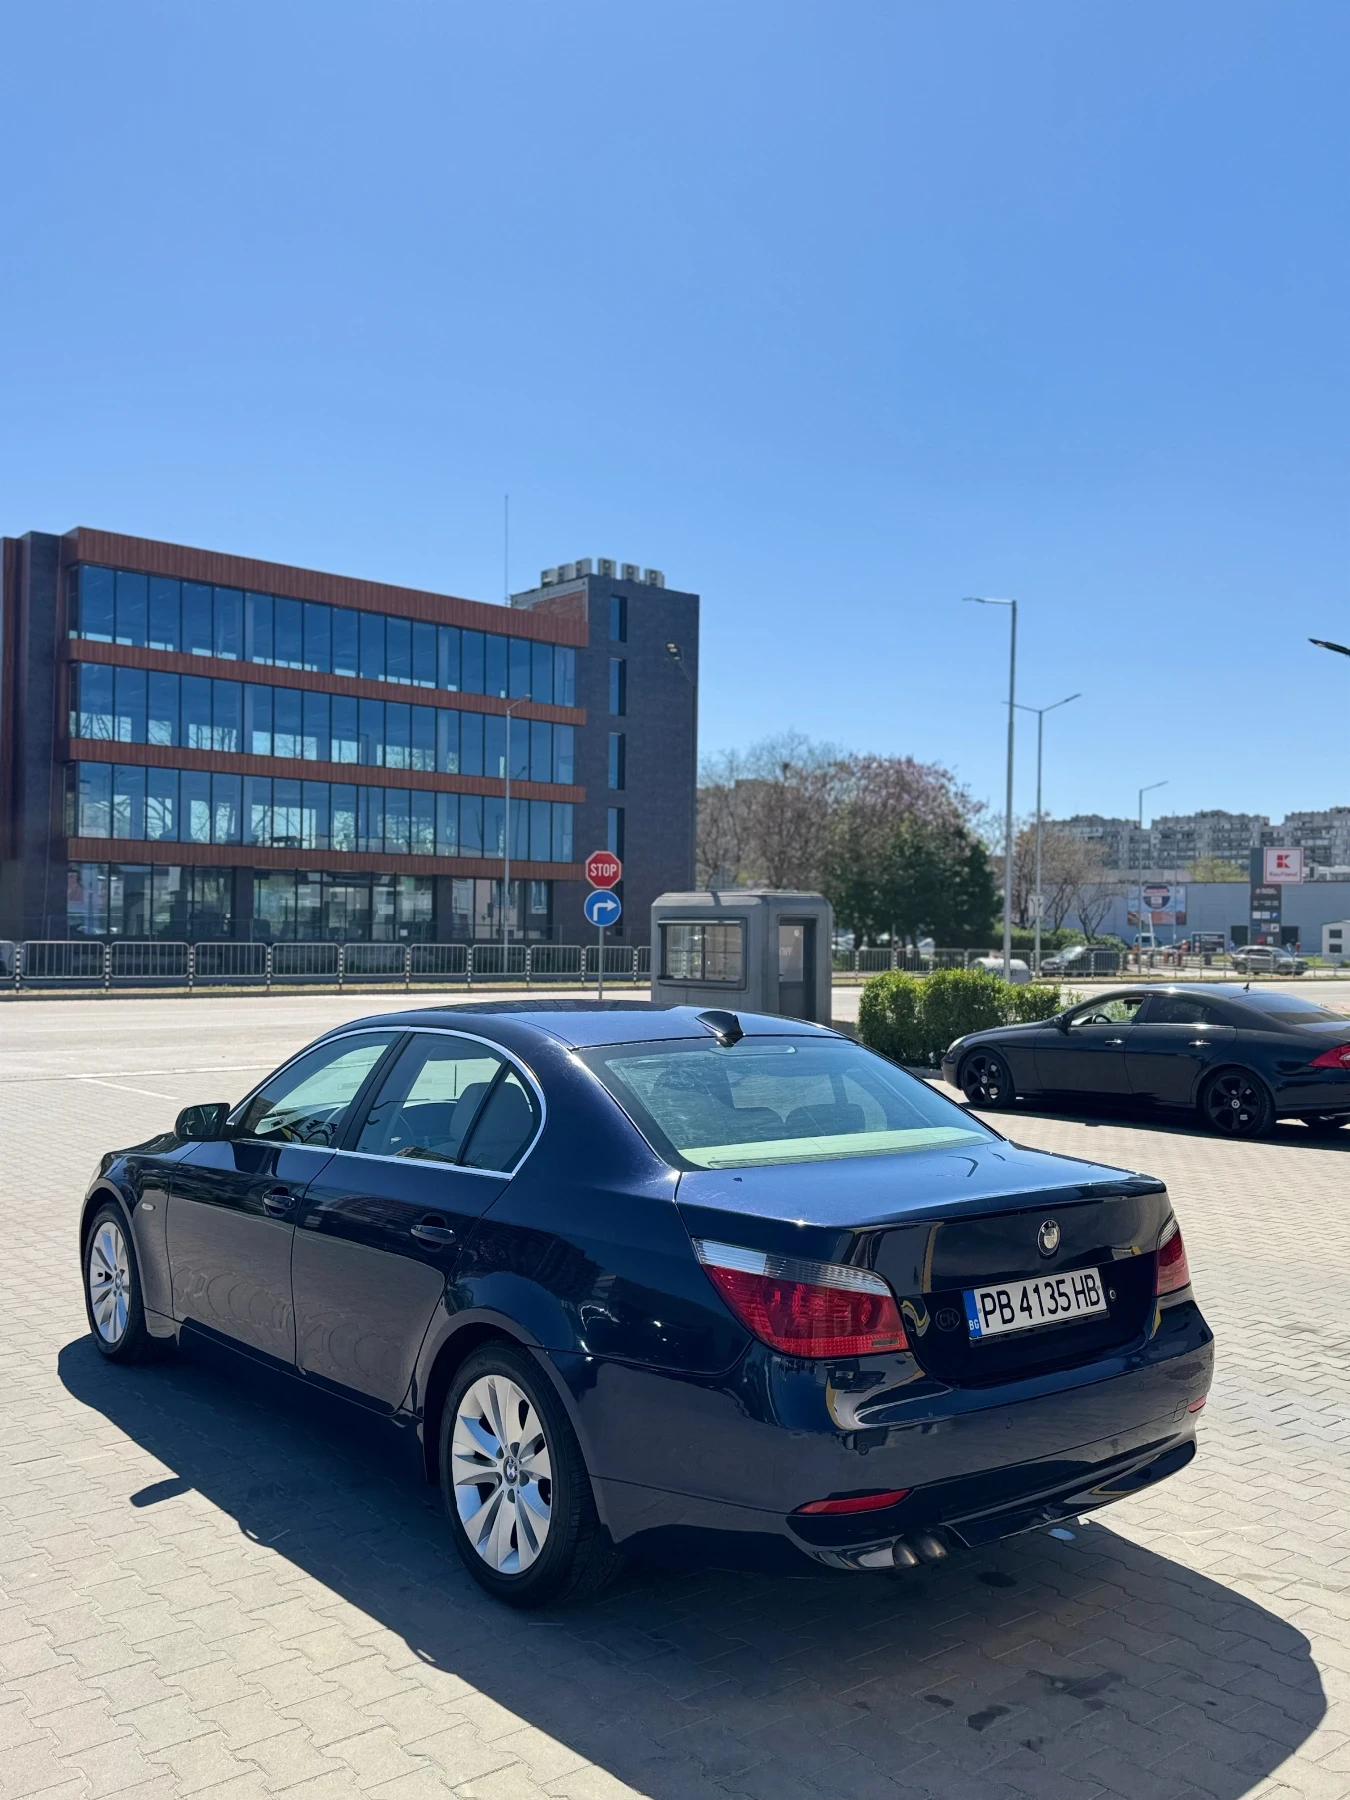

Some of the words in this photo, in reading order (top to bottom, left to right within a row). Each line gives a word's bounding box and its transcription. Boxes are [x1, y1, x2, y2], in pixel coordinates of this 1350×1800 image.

[590, 863, 617, 877] STOP
[980, 1289, 1015, 1329] PB
[1019, 1278, 1071, 1320] 4135
[1071, 1273, 1101, 1310] HB
[968, 1318, 980, 1331] BG
